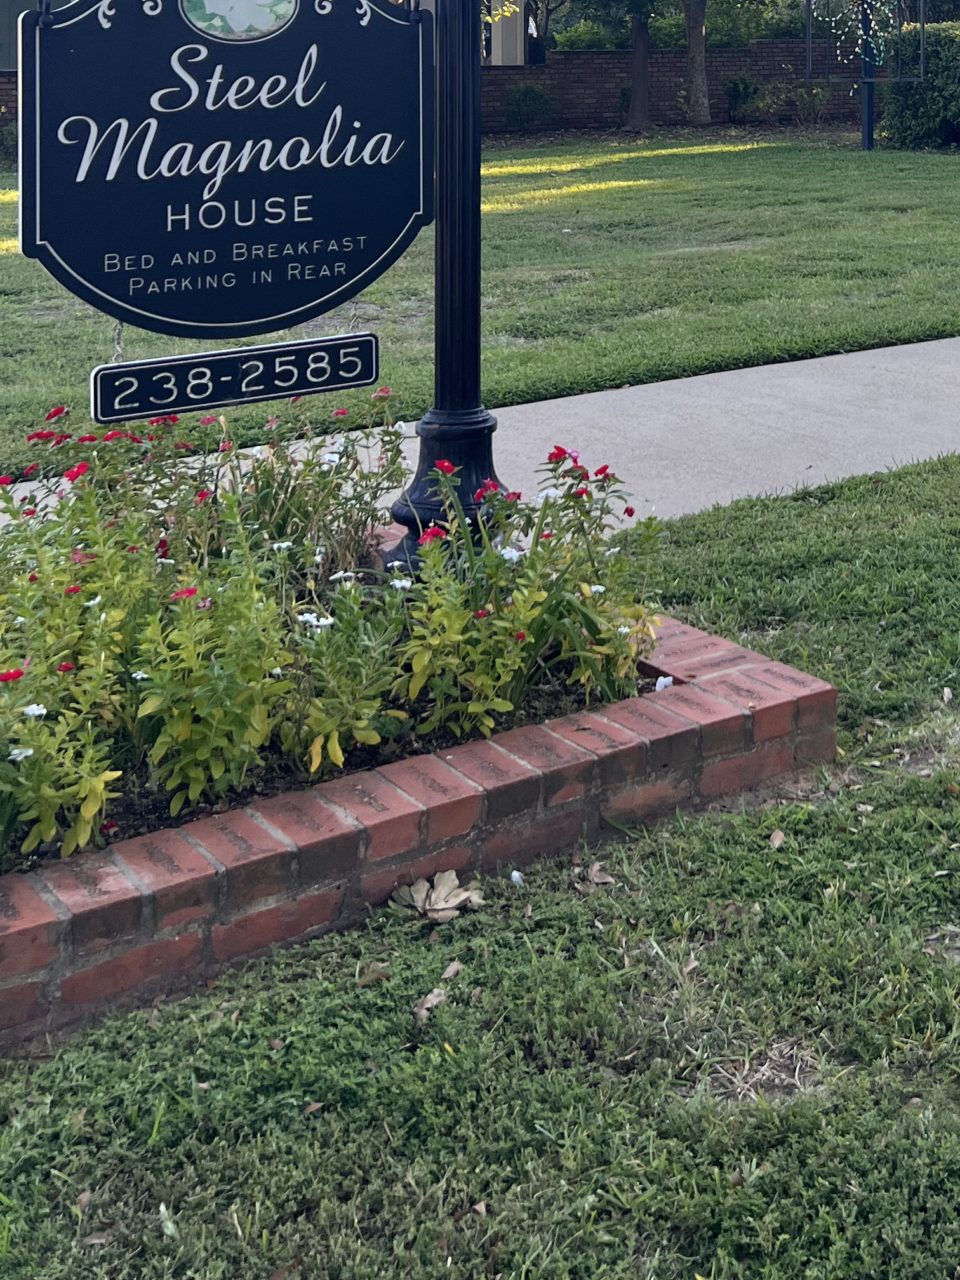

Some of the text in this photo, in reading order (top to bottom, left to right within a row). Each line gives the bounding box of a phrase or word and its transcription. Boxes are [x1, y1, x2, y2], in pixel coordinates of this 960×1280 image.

[150, 43, 326, 113] Steel
[57, 105, 405, 200] Magnolia
[166, 195, 313, 231] HOUSE
[104, 236, 367, 272] BED AND BREAKFAST
[129, 262, 346, 296] PARKING IN REAR
[113, 347, 363, 410] 238-2585
